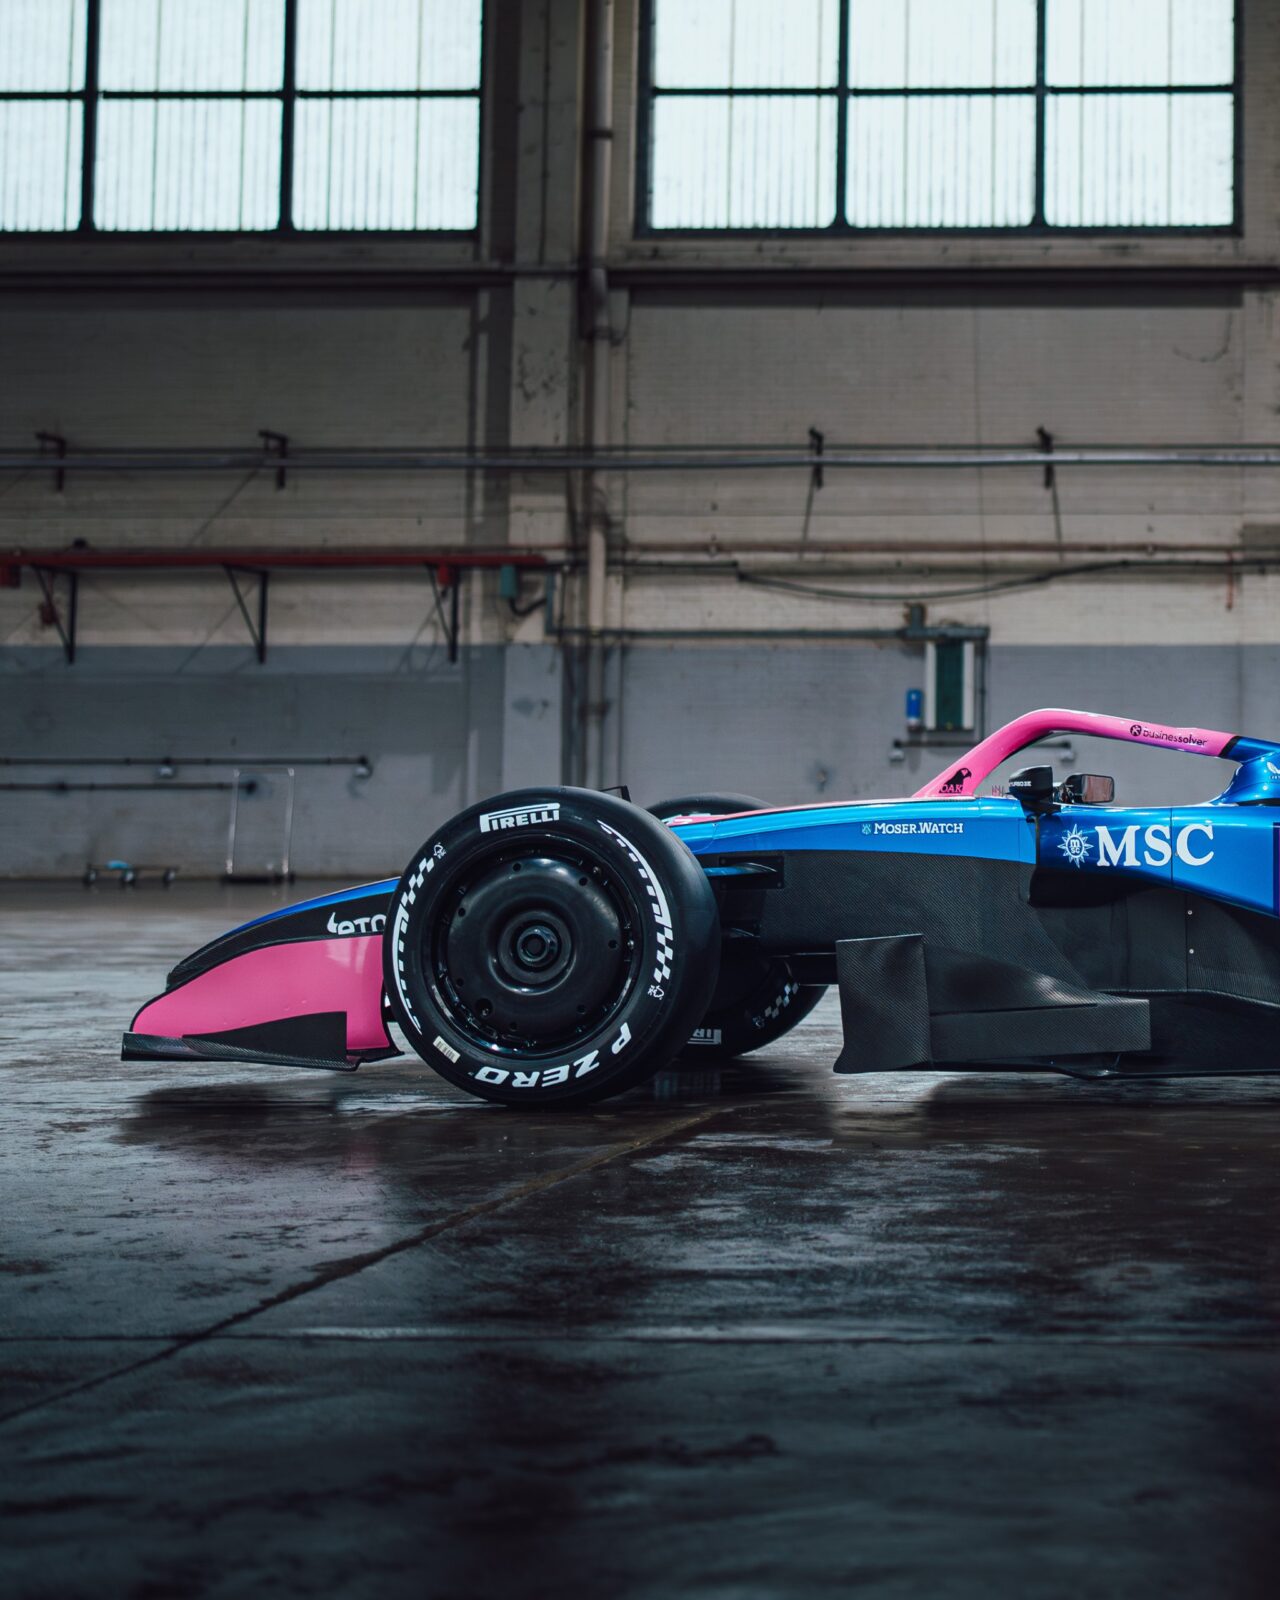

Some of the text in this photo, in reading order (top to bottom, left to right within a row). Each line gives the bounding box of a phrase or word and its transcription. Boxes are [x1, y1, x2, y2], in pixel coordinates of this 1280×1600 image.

[1143, 727, 1208, 746] businessolver
[479, 802, 561, 833] PIRELLI
[1094, 823, 1215, 867] MSC
[474, 1022, 632, 1088] P ZERO
